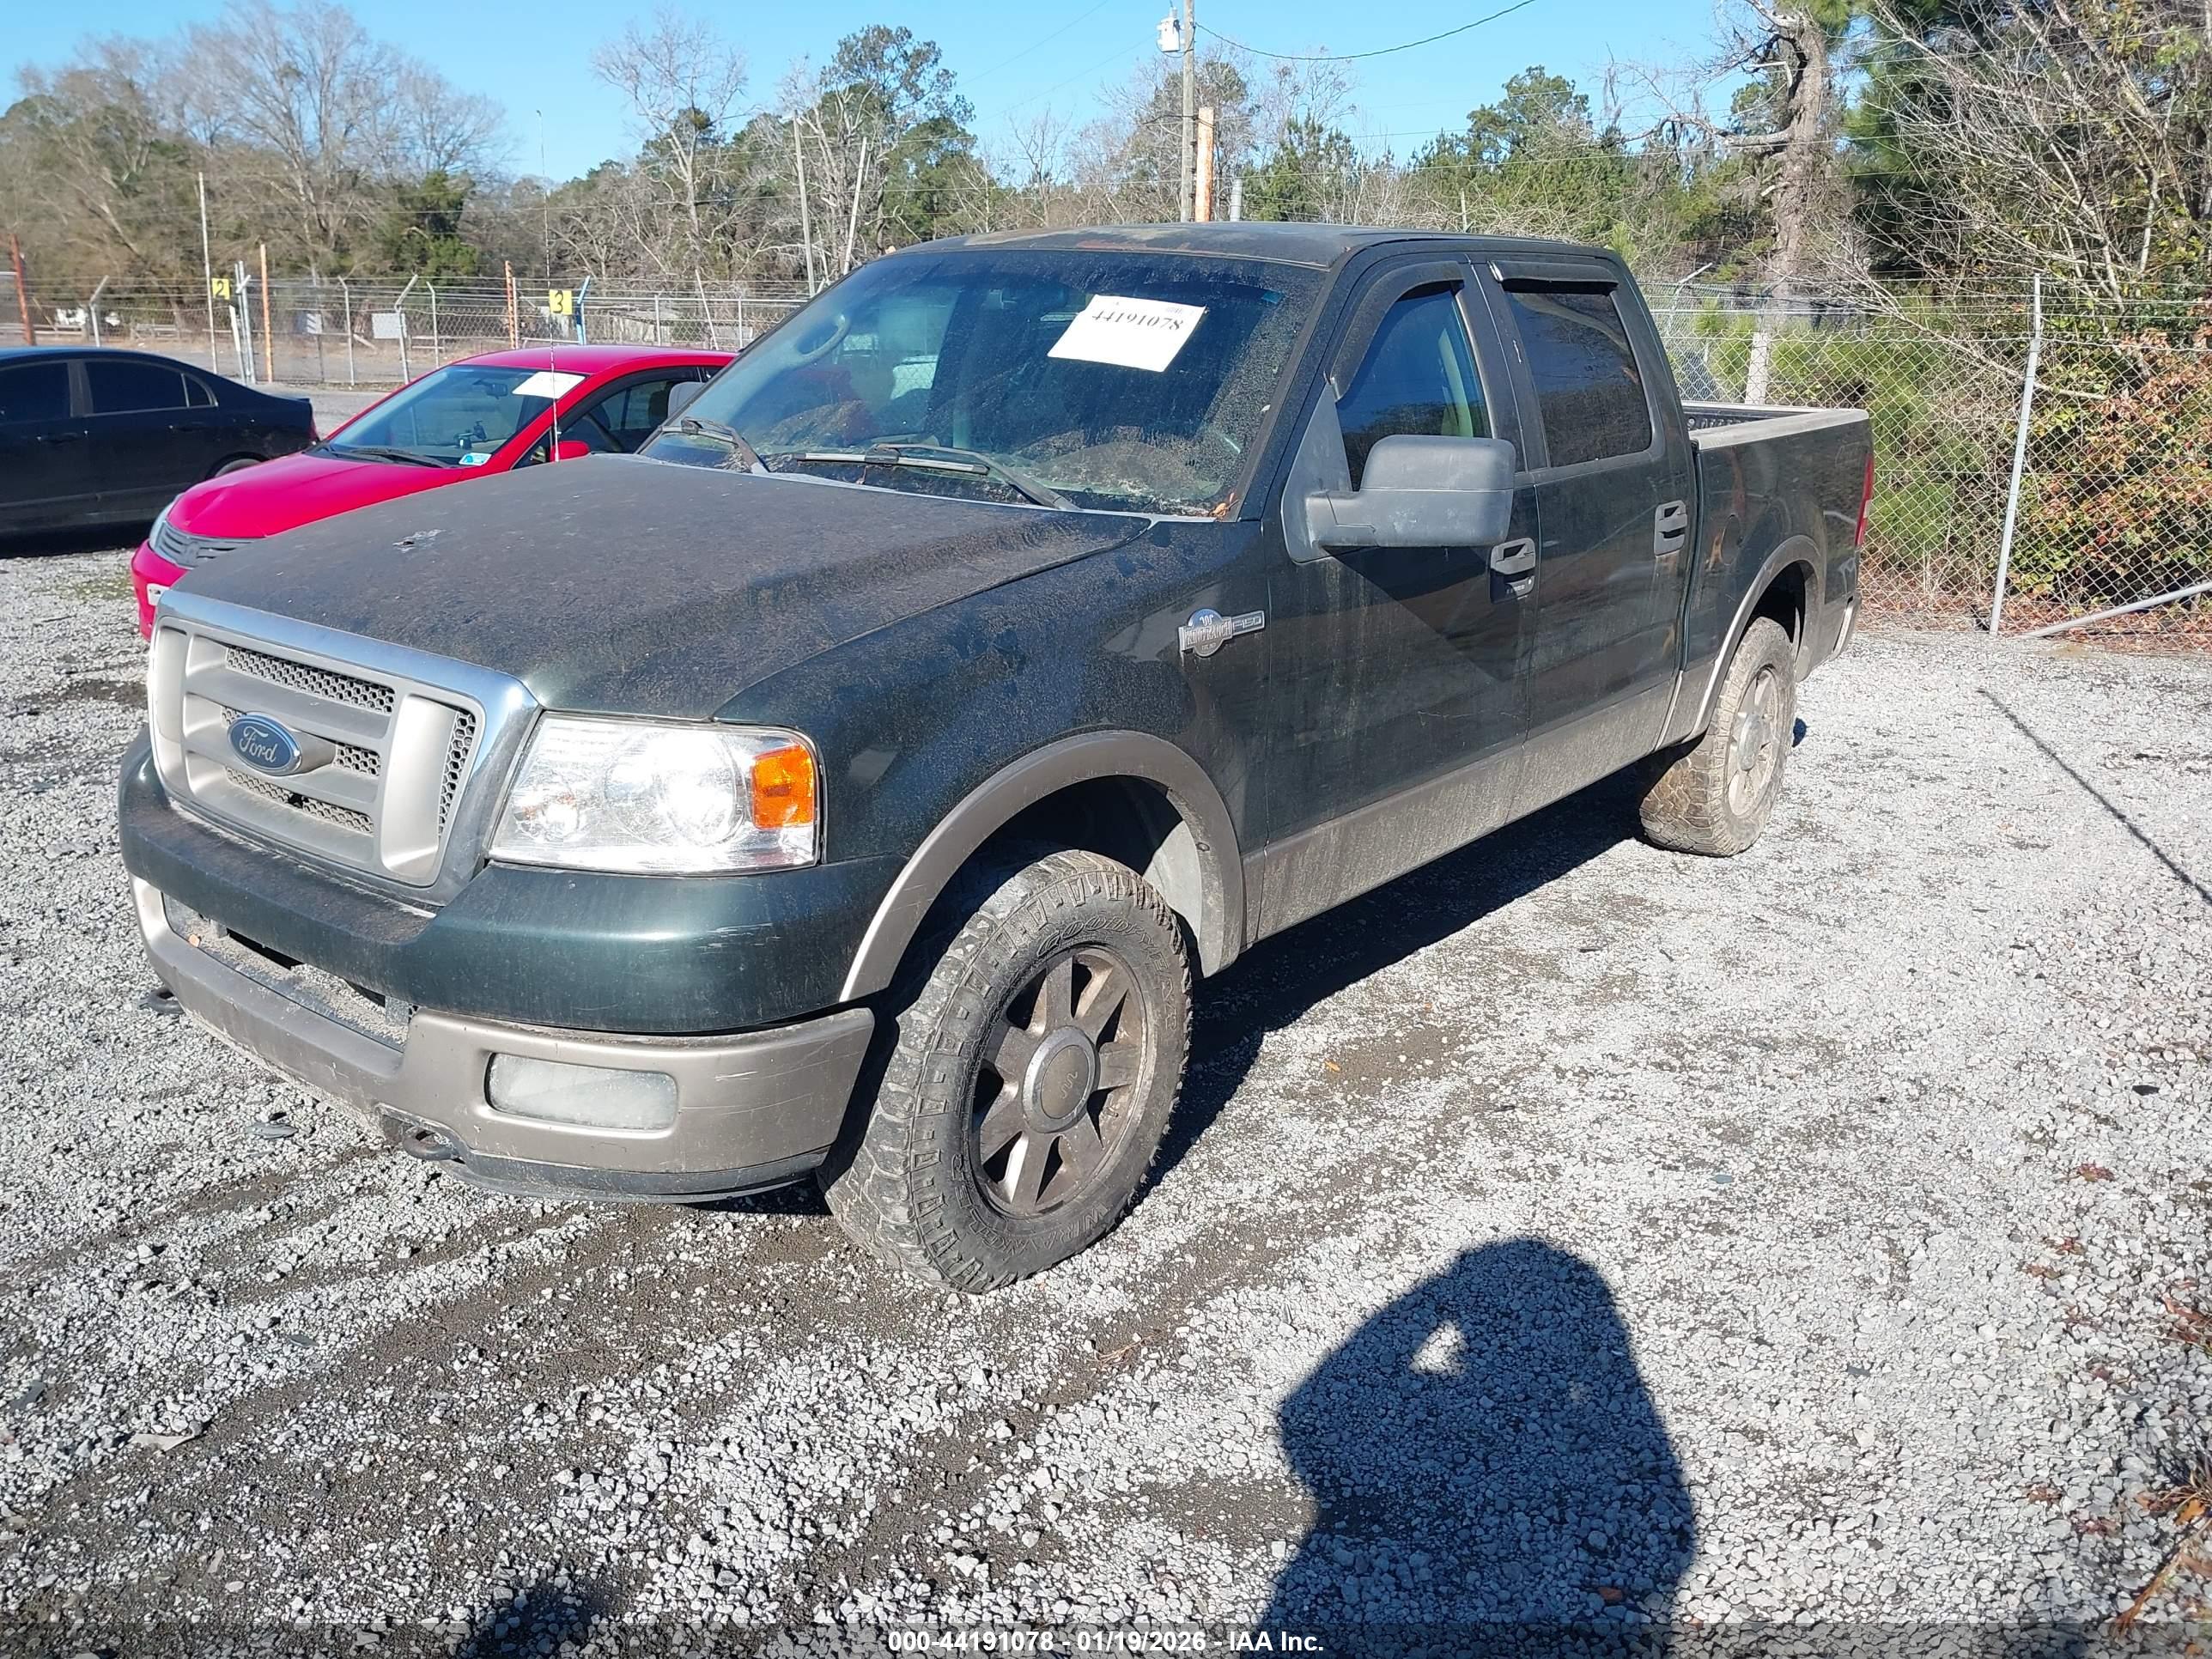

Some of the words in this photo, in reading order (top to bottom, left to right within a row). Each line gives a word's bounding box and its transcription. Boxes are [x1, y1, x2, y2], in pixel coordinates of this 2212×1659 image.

[216, 280, 225, 298] 2
[552, 290, 564, 314] 3
[1091, 310, 1183, 330] 44191078
[240, 726, 278, 763] Ford
[1036, 915, 1178, 1030] GOODYEAR
